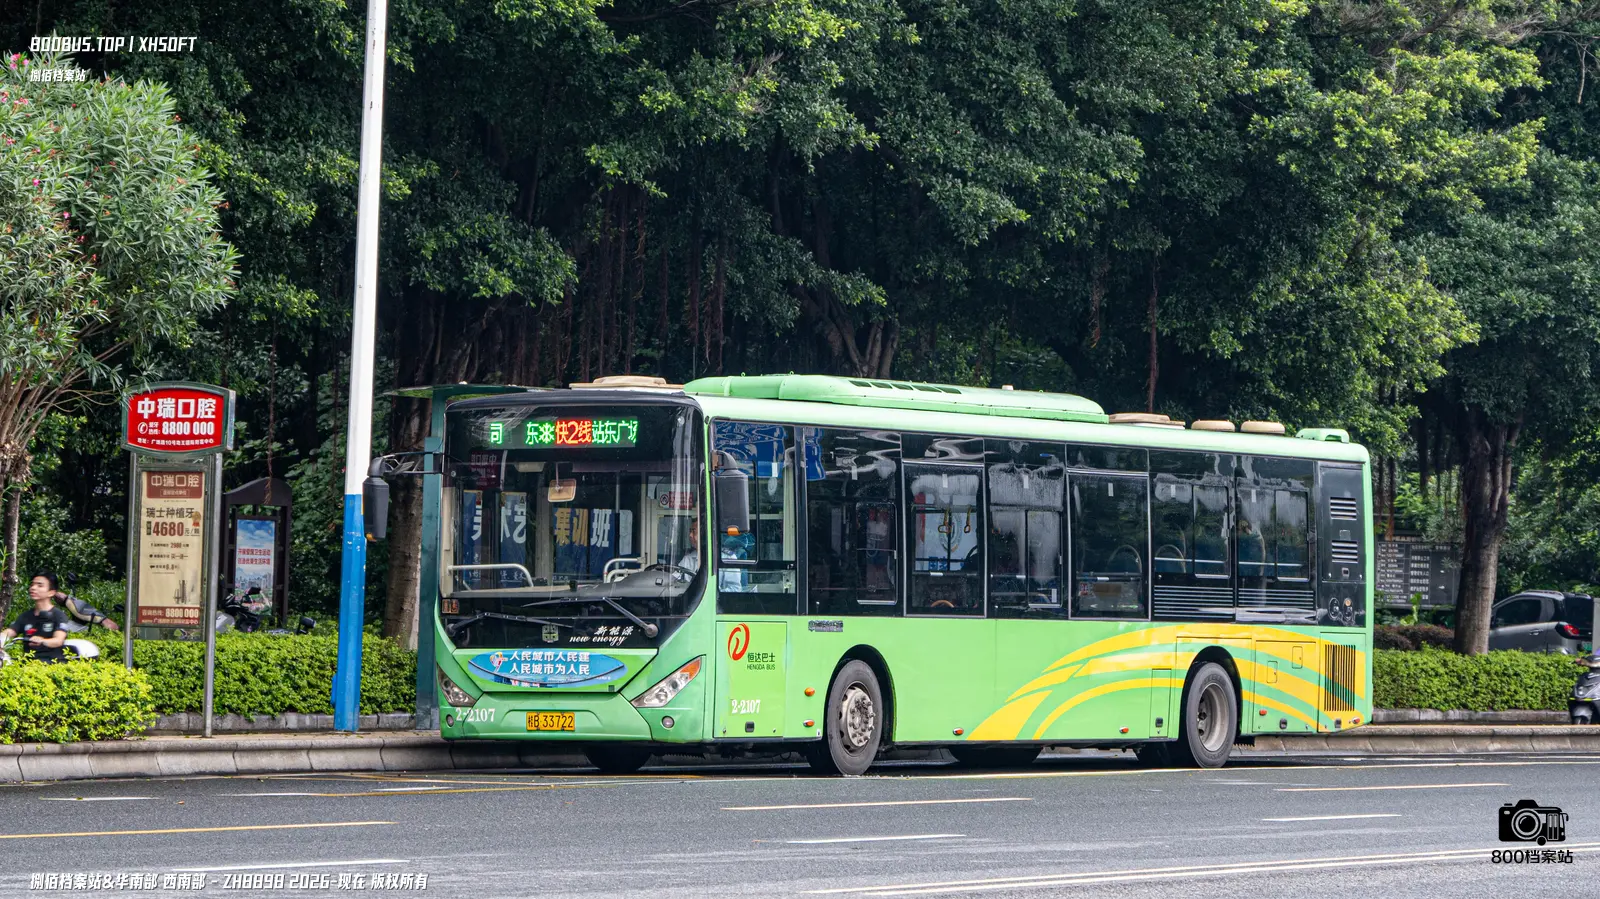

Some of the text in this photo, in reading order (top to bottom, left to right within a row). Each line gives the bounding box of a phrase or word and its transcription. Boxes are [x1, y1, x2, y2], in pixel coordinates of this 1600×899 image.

[137, 397, 216, 419] 中瑞口腔
[162, 421, 214, 435] 8800 000
[490, 422, 503, 444] 司
[151, 474, 200, 488] 中瑞口腔
[146, 507, 195, 519] 瑞士种植牙
[153, 521, 184, 537] 4680
[594, 626, 634, 636] 新能源
[569, 635, 627, 646] new energy
[509, 651, 590, 663] 人民城市人民建
[747, 652, 776, 663] 恒达巴士
[509, 663, 590, 675] 人民城市为人民
[731, 699, 761, 714] 2-2107
[455, 707, 496, 723] 2-2107
